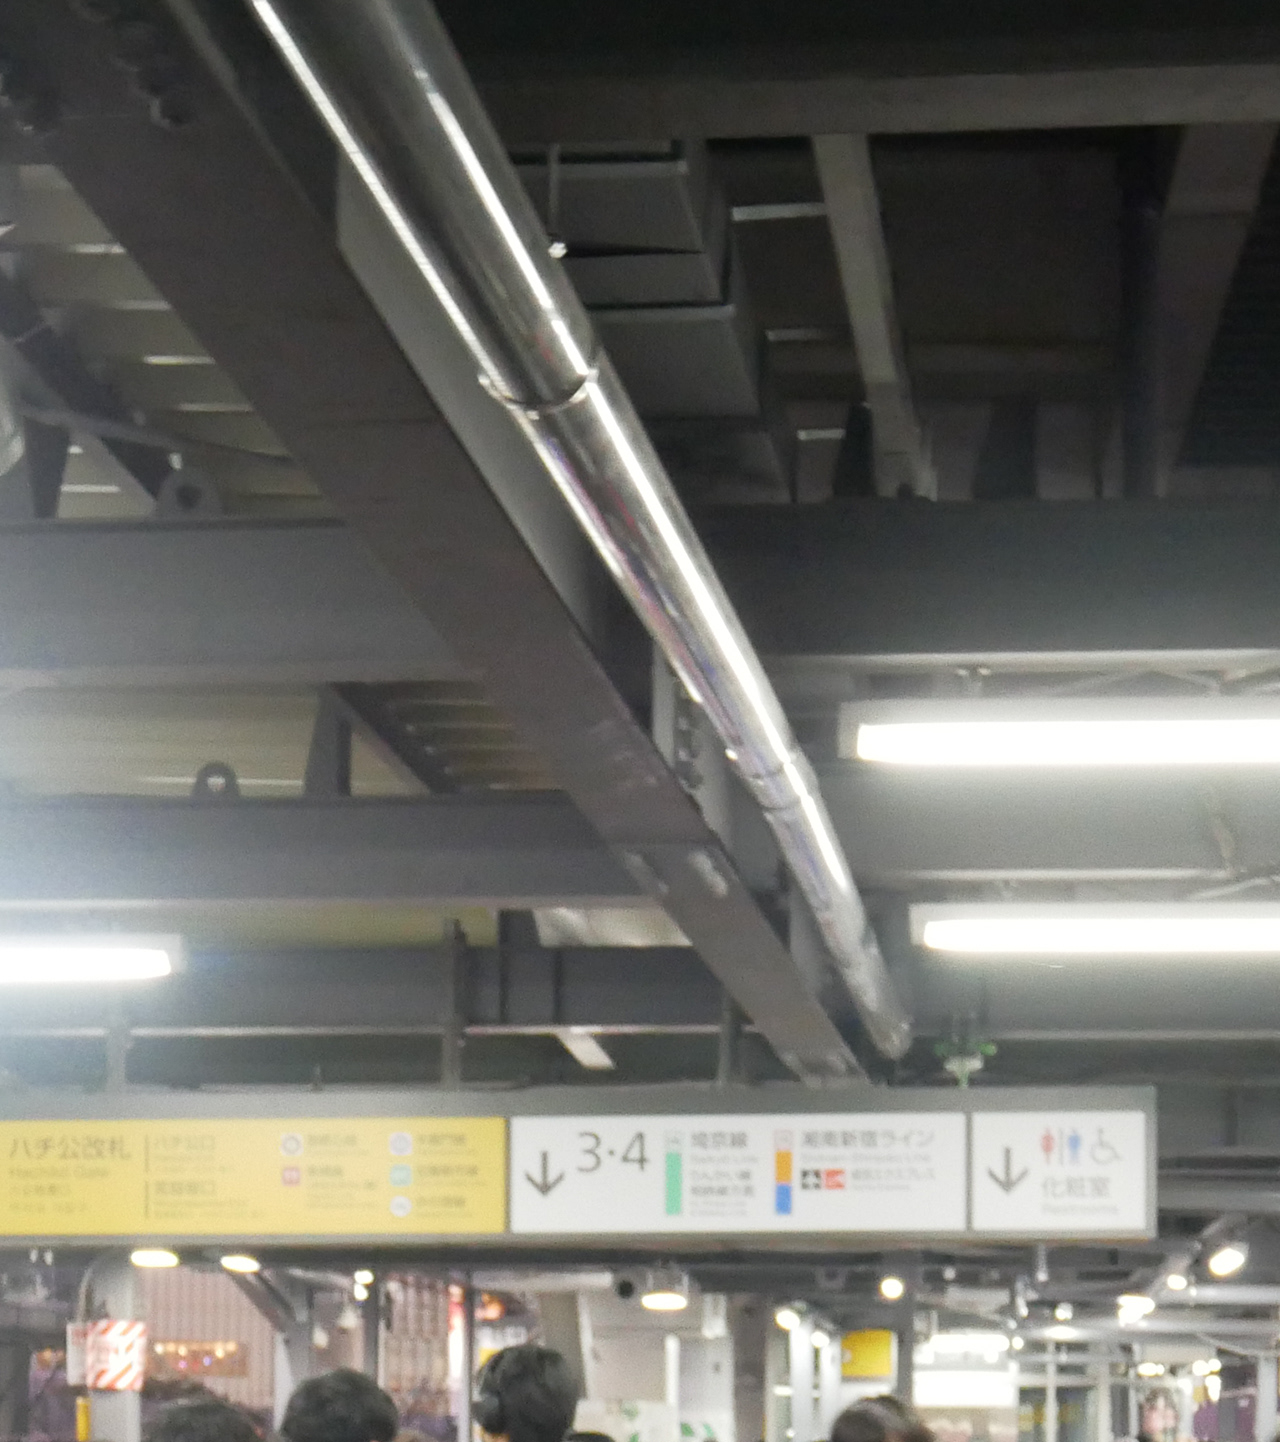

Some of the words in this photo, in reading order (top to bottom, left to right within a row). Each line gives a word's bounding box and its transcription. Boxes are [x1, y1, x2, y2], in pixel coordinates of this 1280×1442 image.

[8, 1134, 132, 1161] ハチ公改札
[690, 1131, 748, 1149] 埼京線
[801, 1129, 935, 1149] 湘南新宿ライン
[1041, 1176, 1111, 1198] 化粧室
